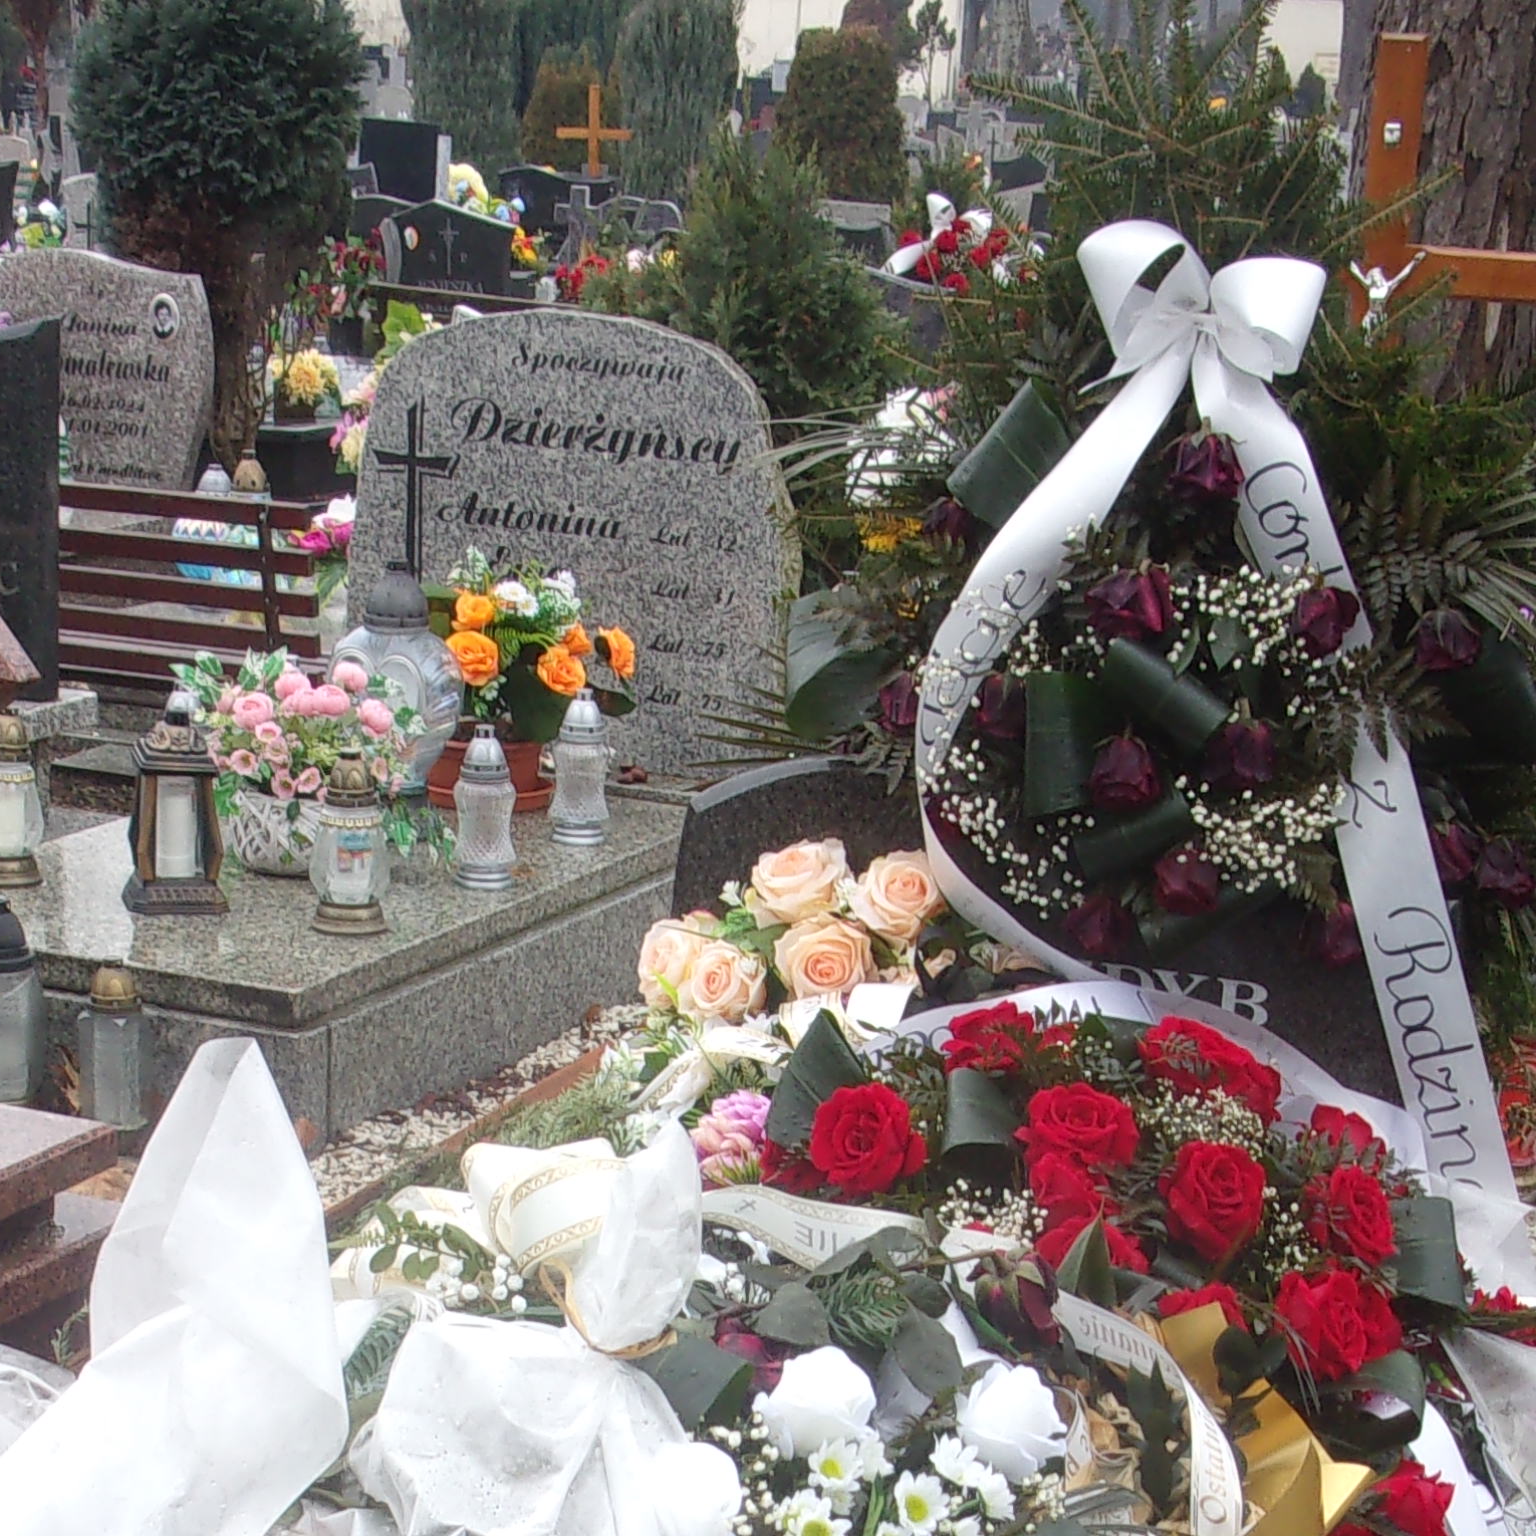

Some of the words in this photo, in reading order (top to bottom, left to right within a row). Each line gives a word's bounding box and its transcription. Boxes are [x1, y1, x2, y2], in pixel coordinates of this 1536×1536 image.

[450, 397, 742, 475] Dzierżyńscy
[436, 492, 622, 540] Antonina
[1374, 906, 1484, 1190] Rodzin
